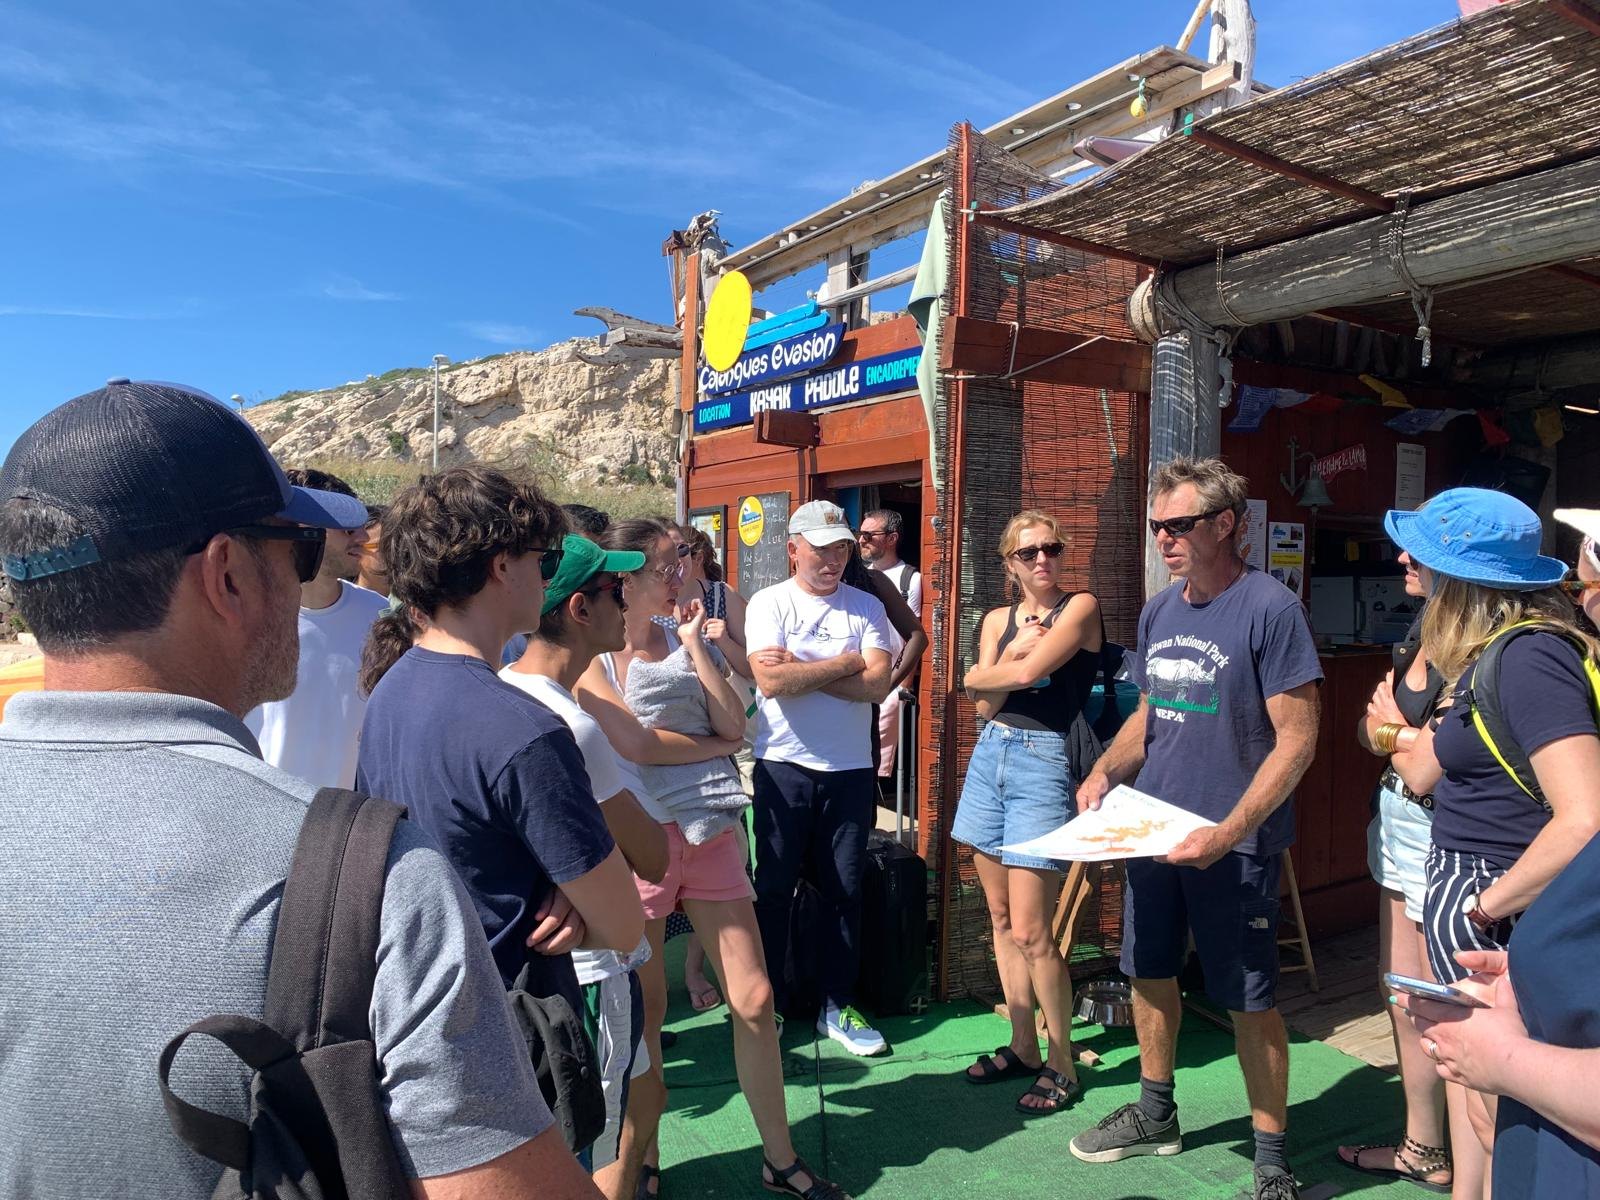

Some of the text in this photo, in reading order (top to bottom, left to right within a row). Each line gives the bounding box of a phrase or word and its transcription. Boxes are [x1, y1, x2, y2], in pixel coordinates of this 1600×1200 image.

[699, 402, 731, 424] LOCATION
[750, 383, 791, 417] KAYAK
[1174, 634, 1212, 653] National
[1206, 642, 1230, 669] Park
